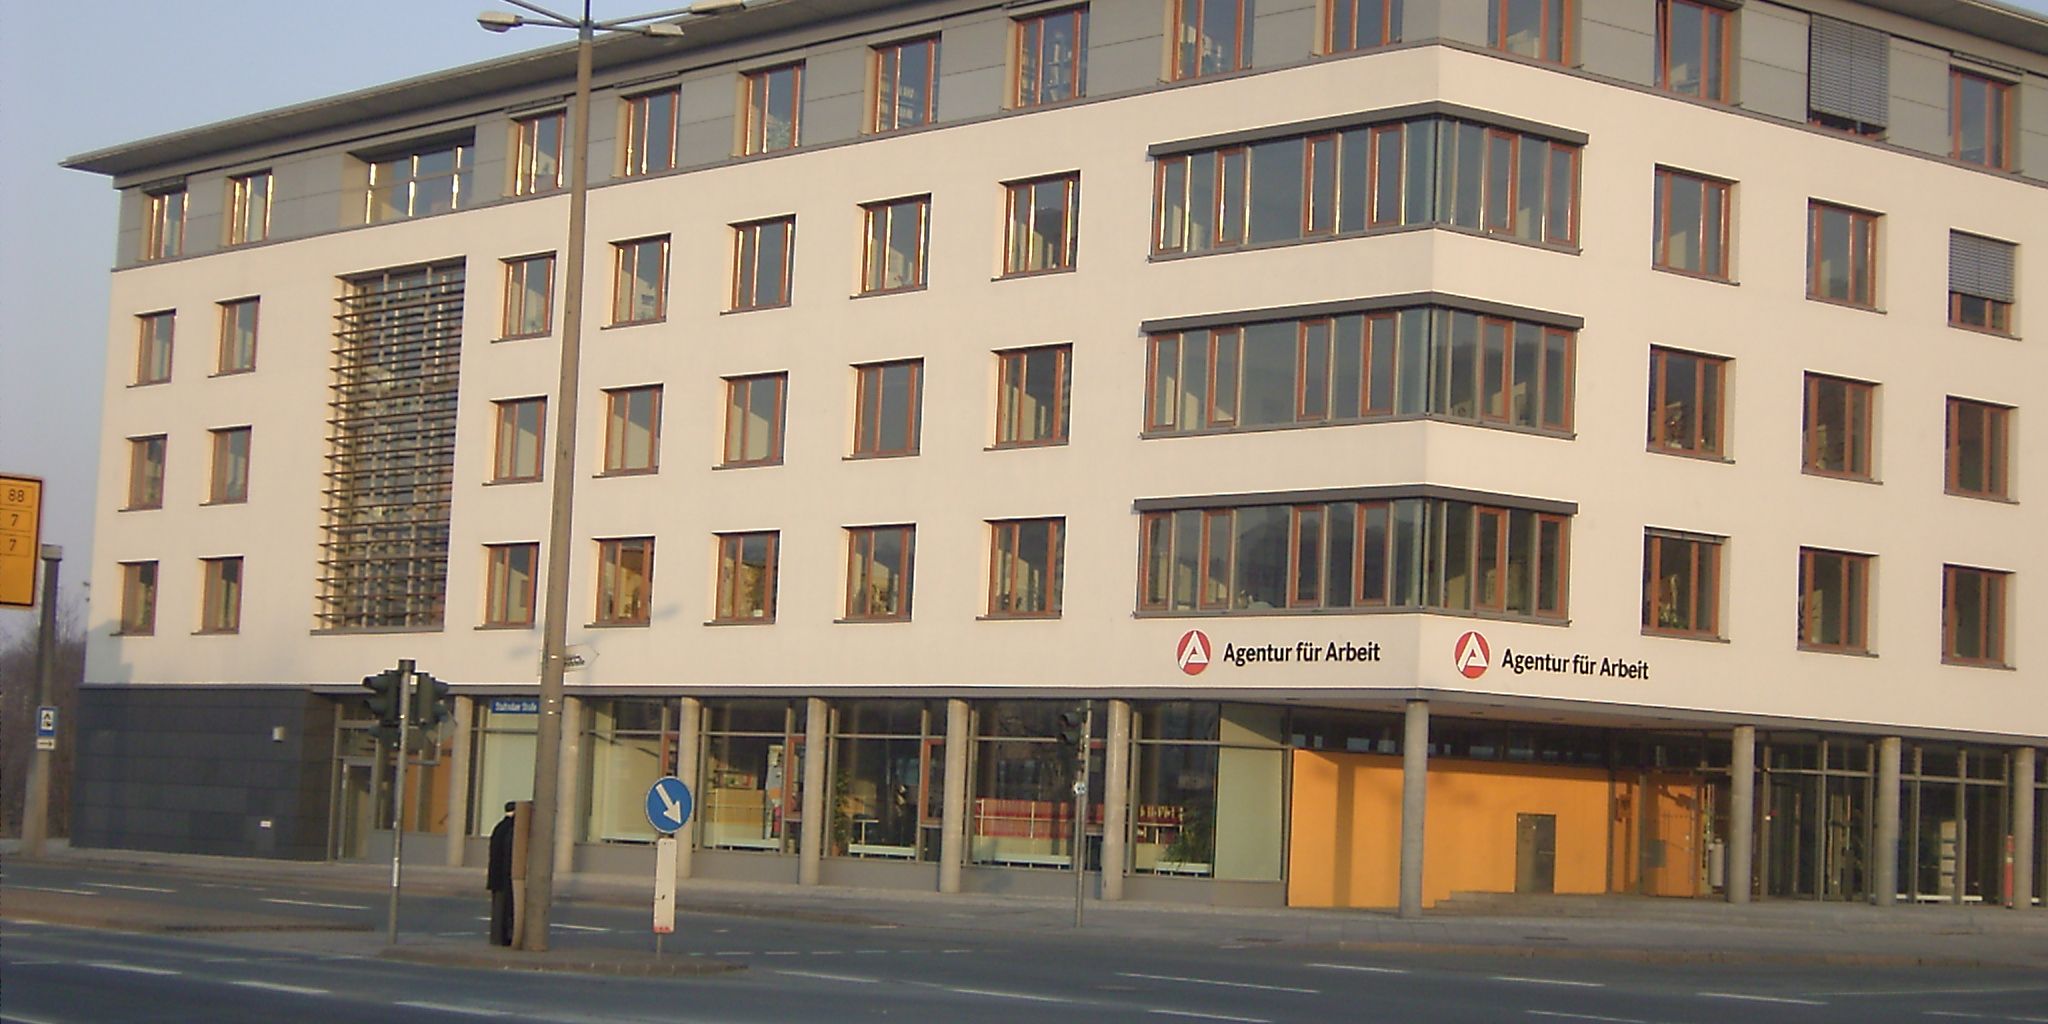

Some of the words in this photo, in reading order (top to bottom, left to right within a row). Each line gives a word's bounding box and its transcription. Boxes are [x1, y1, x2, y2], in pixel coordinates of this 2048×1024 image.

[8, 489, 24, 503] 88
[11, 513, 19, 527] 7
[10, 538, 17, 551] 7
[1223, 642, 1292, 666] Agentur
[1295, 641, 1322, 662] für
[1325, 641, 1381, 662] Arbeit
[1501, 649, 1569, 674] Agentur
[1573, 654, 1597, 674] für
[1600, 657, 1648, 679] Arbeit
